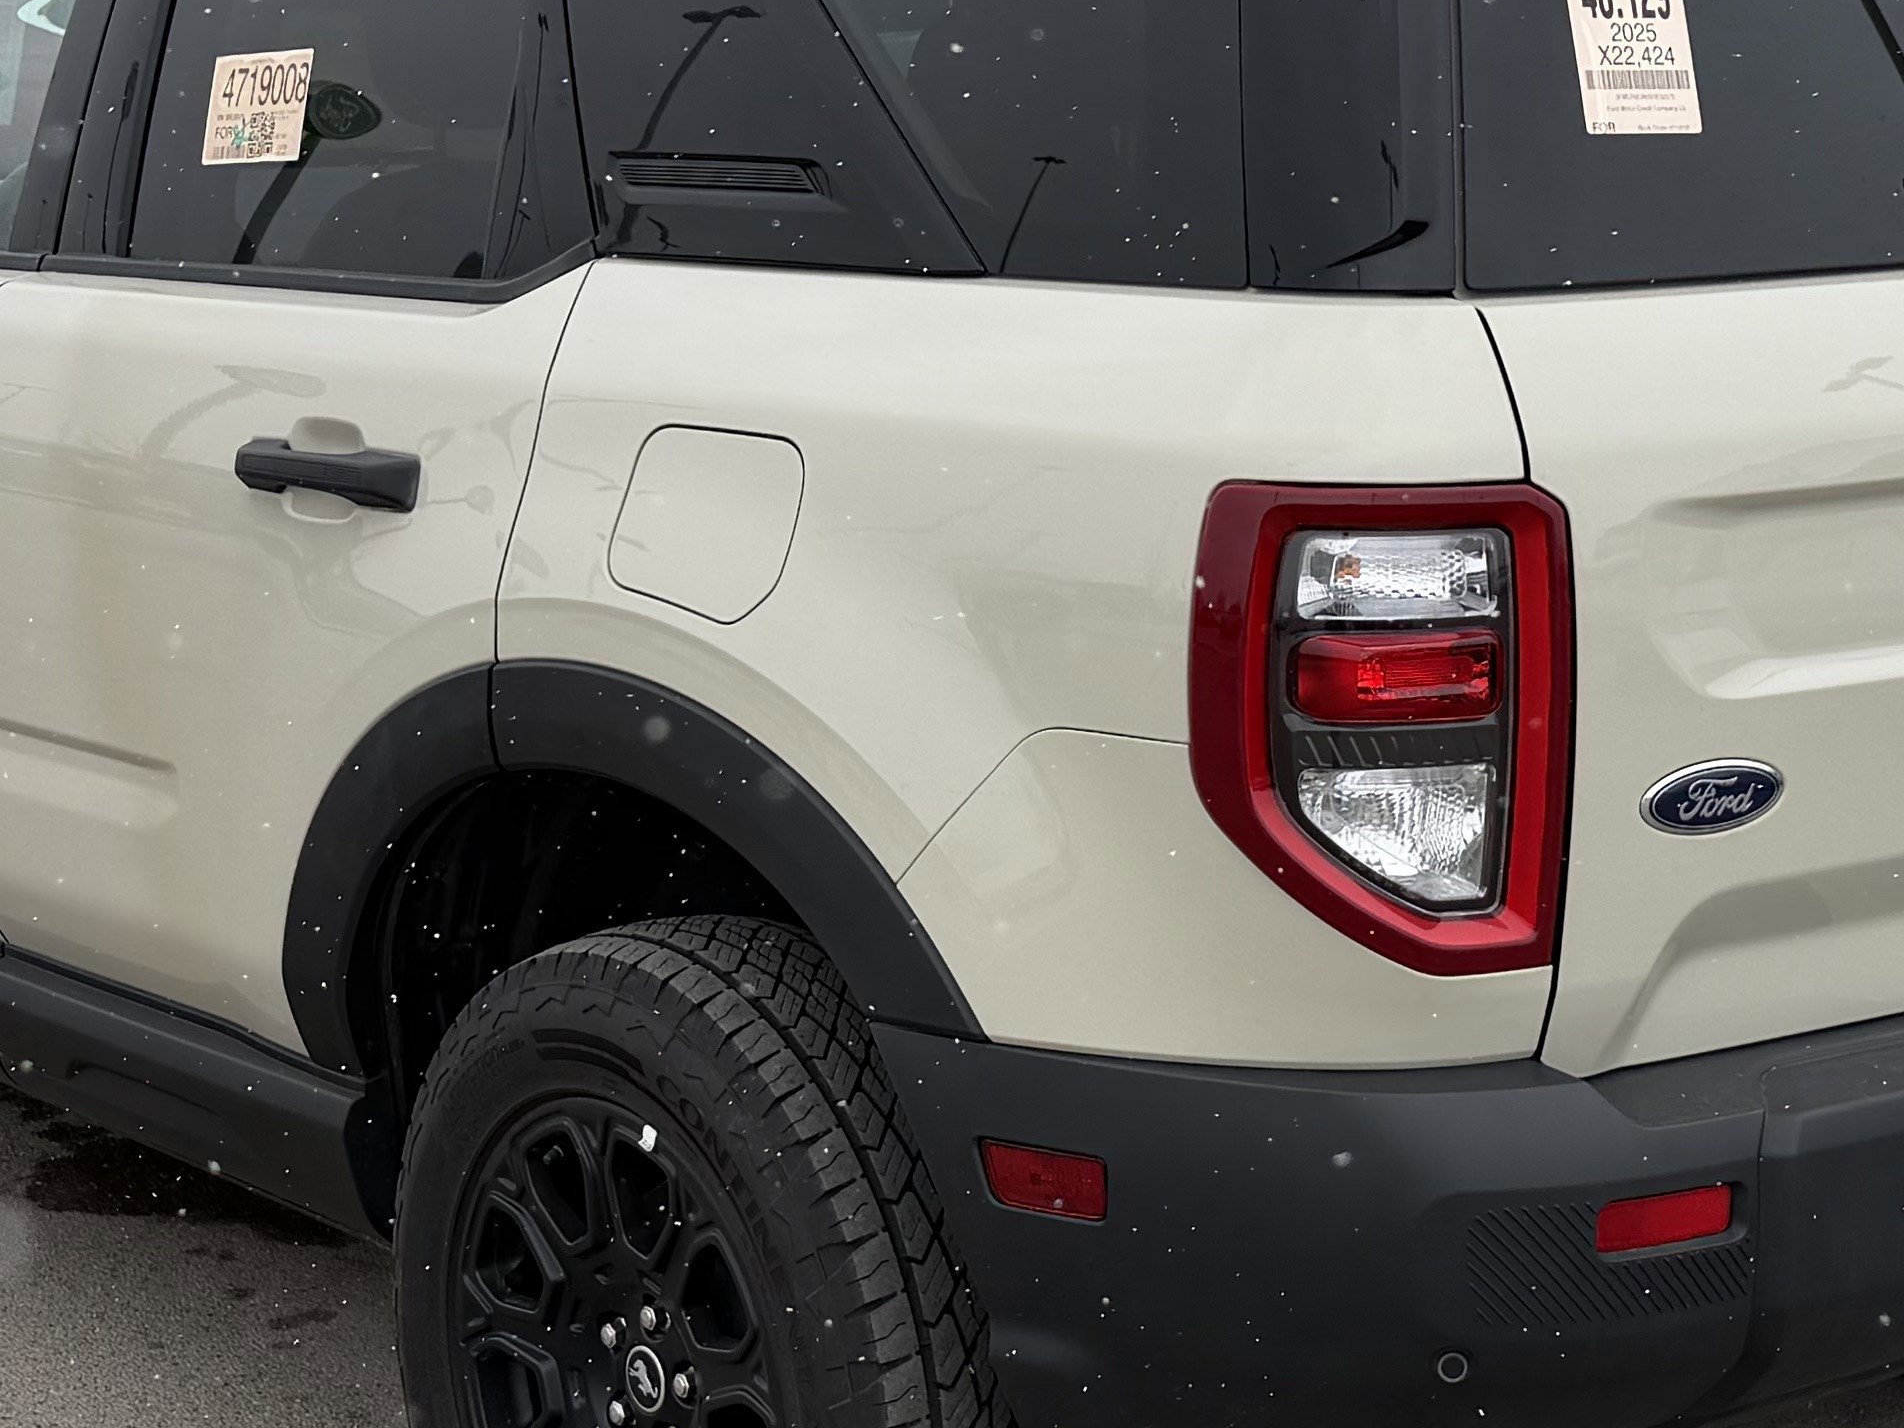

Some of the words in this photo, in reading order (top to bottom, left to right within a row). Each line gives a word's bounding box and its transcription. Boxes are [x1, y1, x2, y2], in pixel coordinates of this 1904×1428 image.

[1609, 22, 1658, 43] 2025
[1597, 45, 1676, 68] X22,424
[222, 61, 310, 107] 4719008
[1679, 776, 1757, 822] Ford
